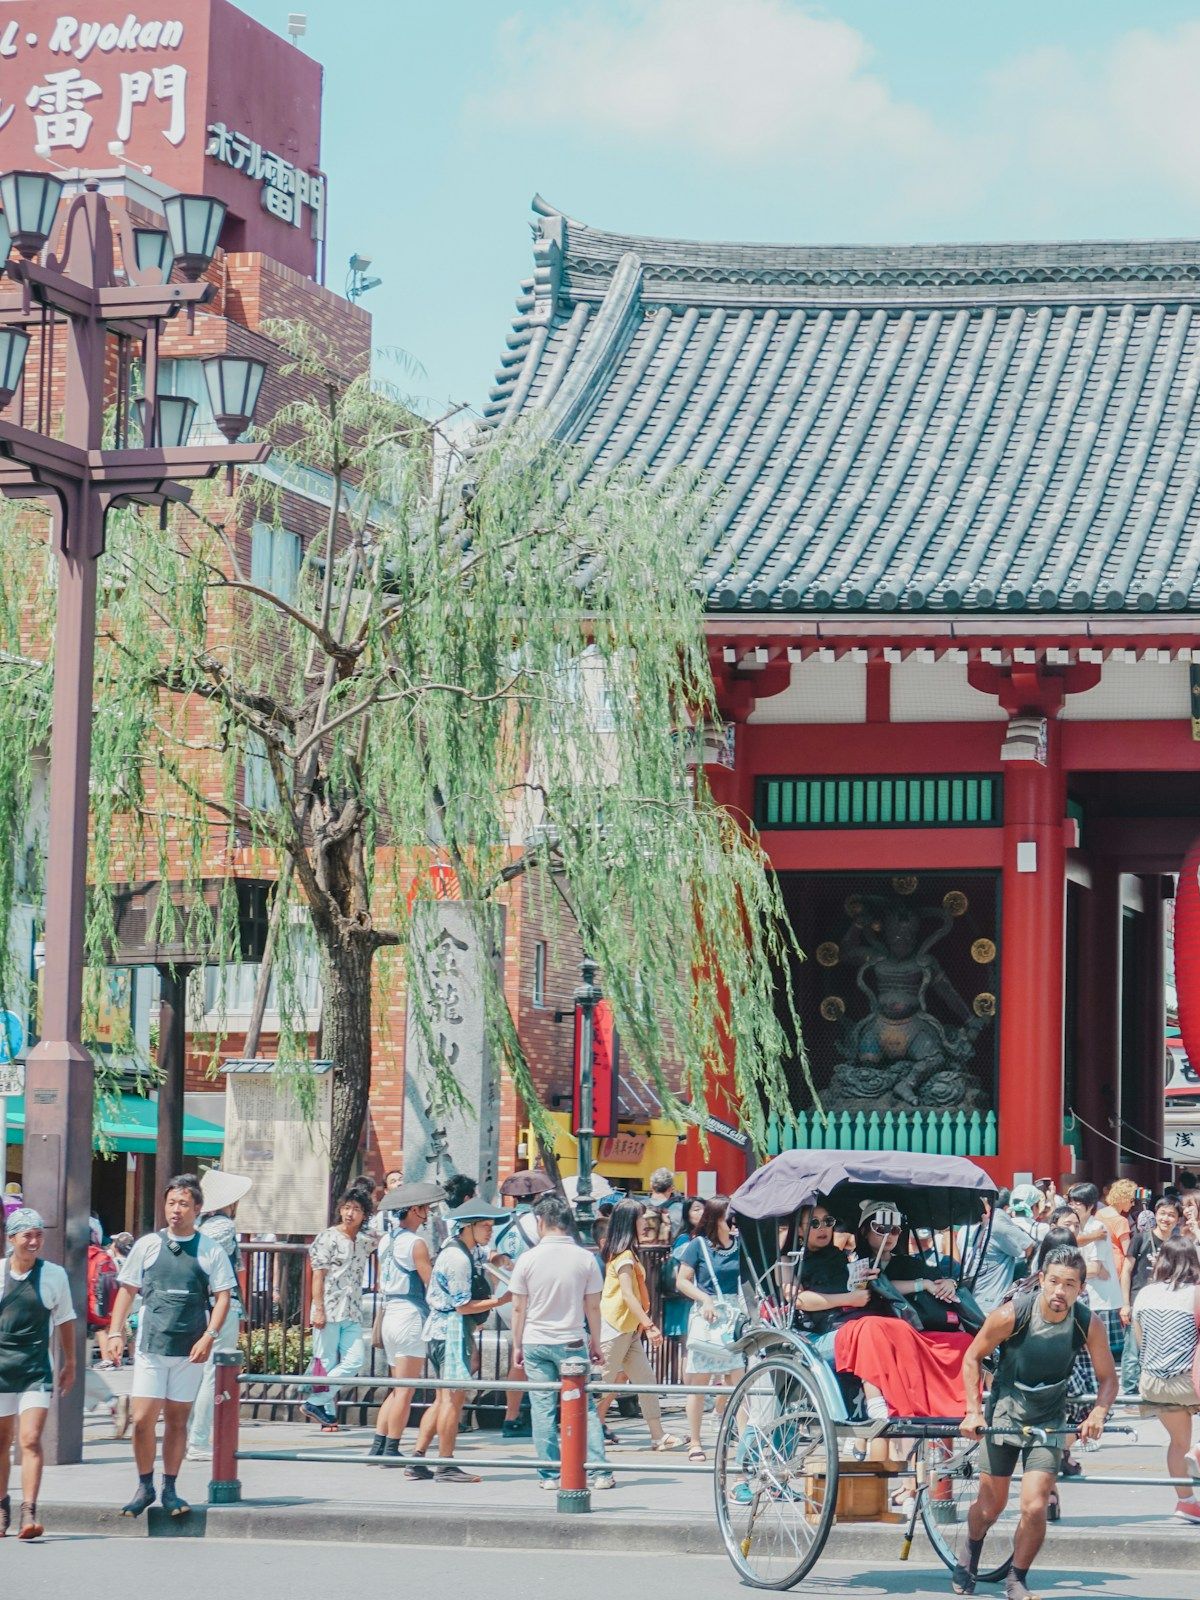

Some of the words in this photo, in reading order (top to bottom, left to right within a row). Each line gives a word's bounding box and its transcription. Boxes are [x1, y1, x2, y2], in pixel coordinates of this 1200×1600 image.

[49, 14, 184, 60] Ryokan
[0, 64, 188, 149] 雷門
[206, 122, 324, 241] ホテル雷門
[1175, 1132, 1195, 1148] 浅
